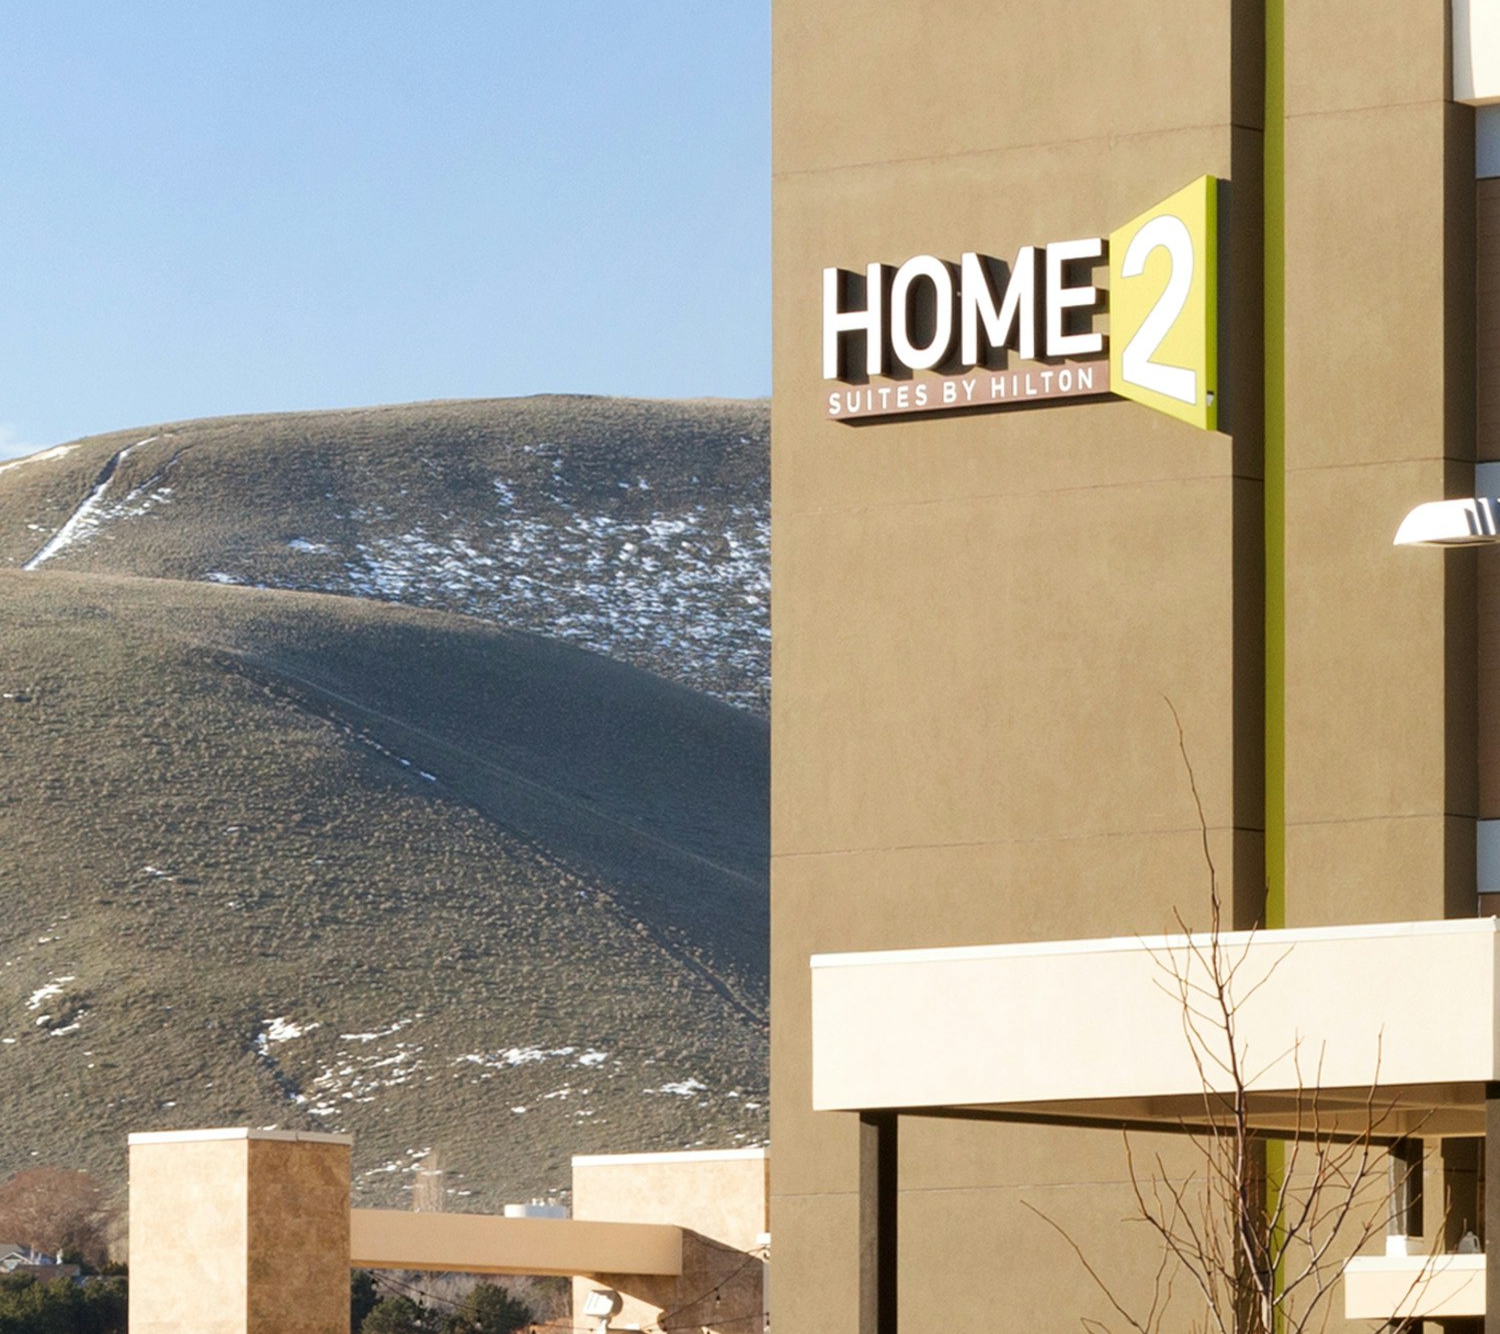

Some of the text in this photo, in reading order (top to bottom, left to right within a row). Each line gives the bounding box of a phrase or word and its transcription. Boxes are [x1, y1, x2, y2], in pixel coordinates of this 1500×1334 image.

[823, 214, 1197, 407] HOME 2
[828, 367, 1093, 415] SUITES BY HILTON
